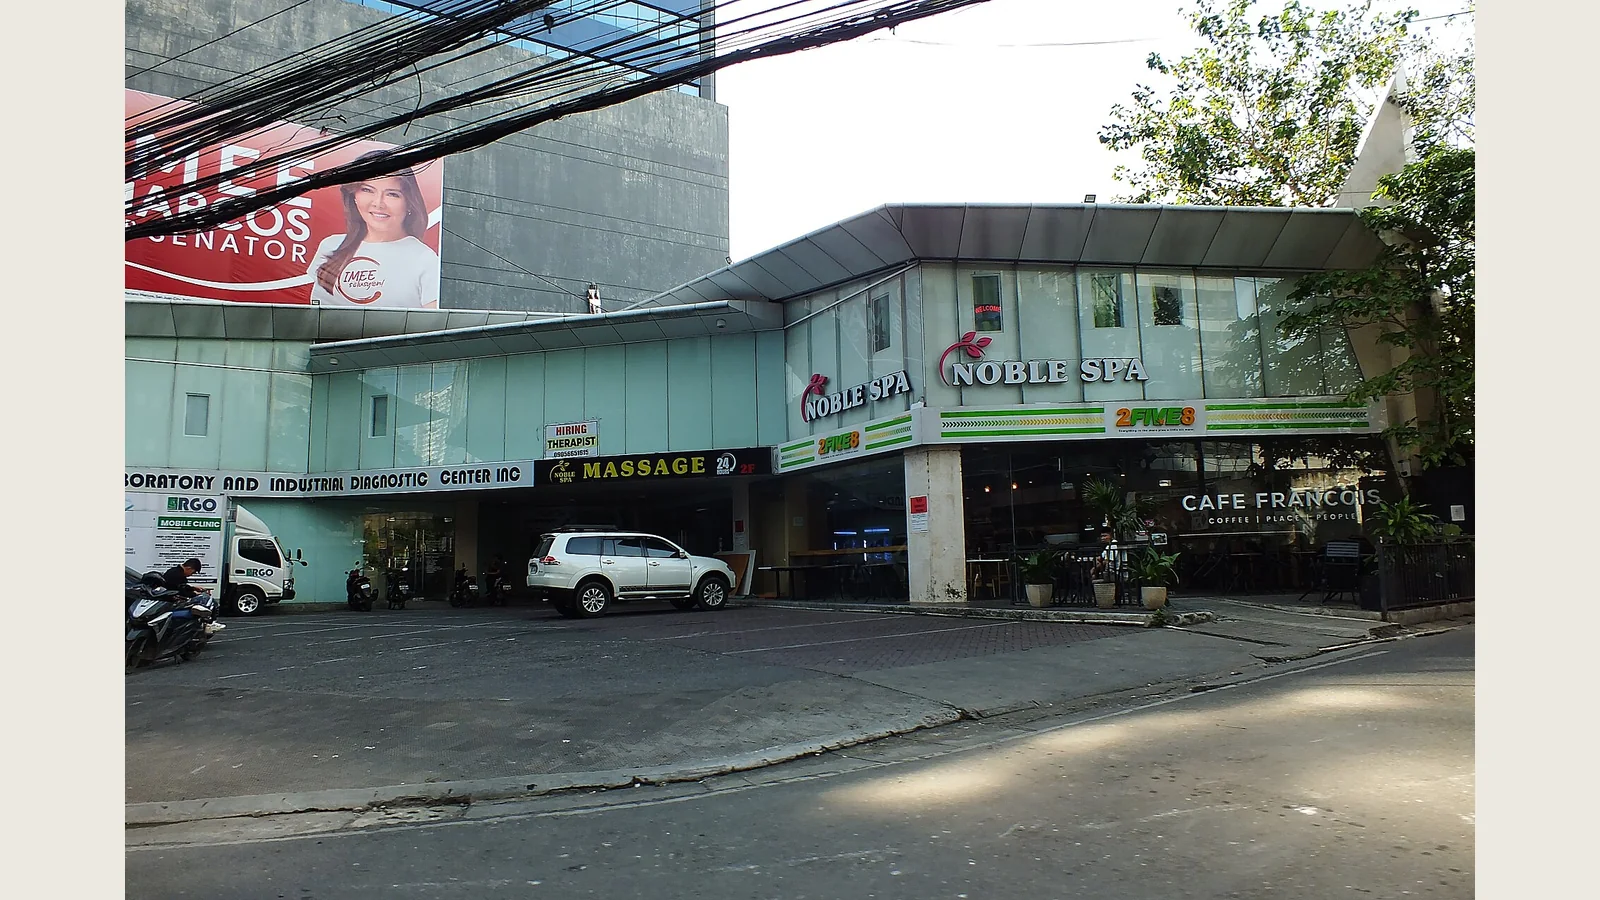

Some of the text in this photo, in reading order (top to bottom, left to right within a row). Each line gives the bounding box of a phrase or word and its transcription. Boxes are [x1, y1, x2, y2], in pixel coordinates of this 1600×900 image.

[343, 270, 377, 282] IMEE
[975, 305, 1001, 314] WELCOME
[952, 358, 1150, 387] NOBLE SPA
[805, 370, 910, 423] NOBLE SPA
[1116, 406, 1196, 427] 2FIVE8
[556, 424, 587, 436] HIRING
[547, 436, 596, 449] THERAPIST
[583, 457, 706, 479] MASSAGE
[717, 457, 730, 469] 24
[740, 463, 755, 474] 2F
[223, 476, 260, 491] AND
[270, 477, 344, 492] INDUSTRIAL
[351, 472, 428, 489] DIAGNOSTIC
[440, 469, 491, 485] CENTER
[496, 467, 521, 482] INC
[1181, 489, 1381, 511] CAFE FRANCOIS
[160, 519, 221, 528] MOBILE CLINIC
[1208, 512, 1356, 524] COFFEE PLACE PEOPLE
